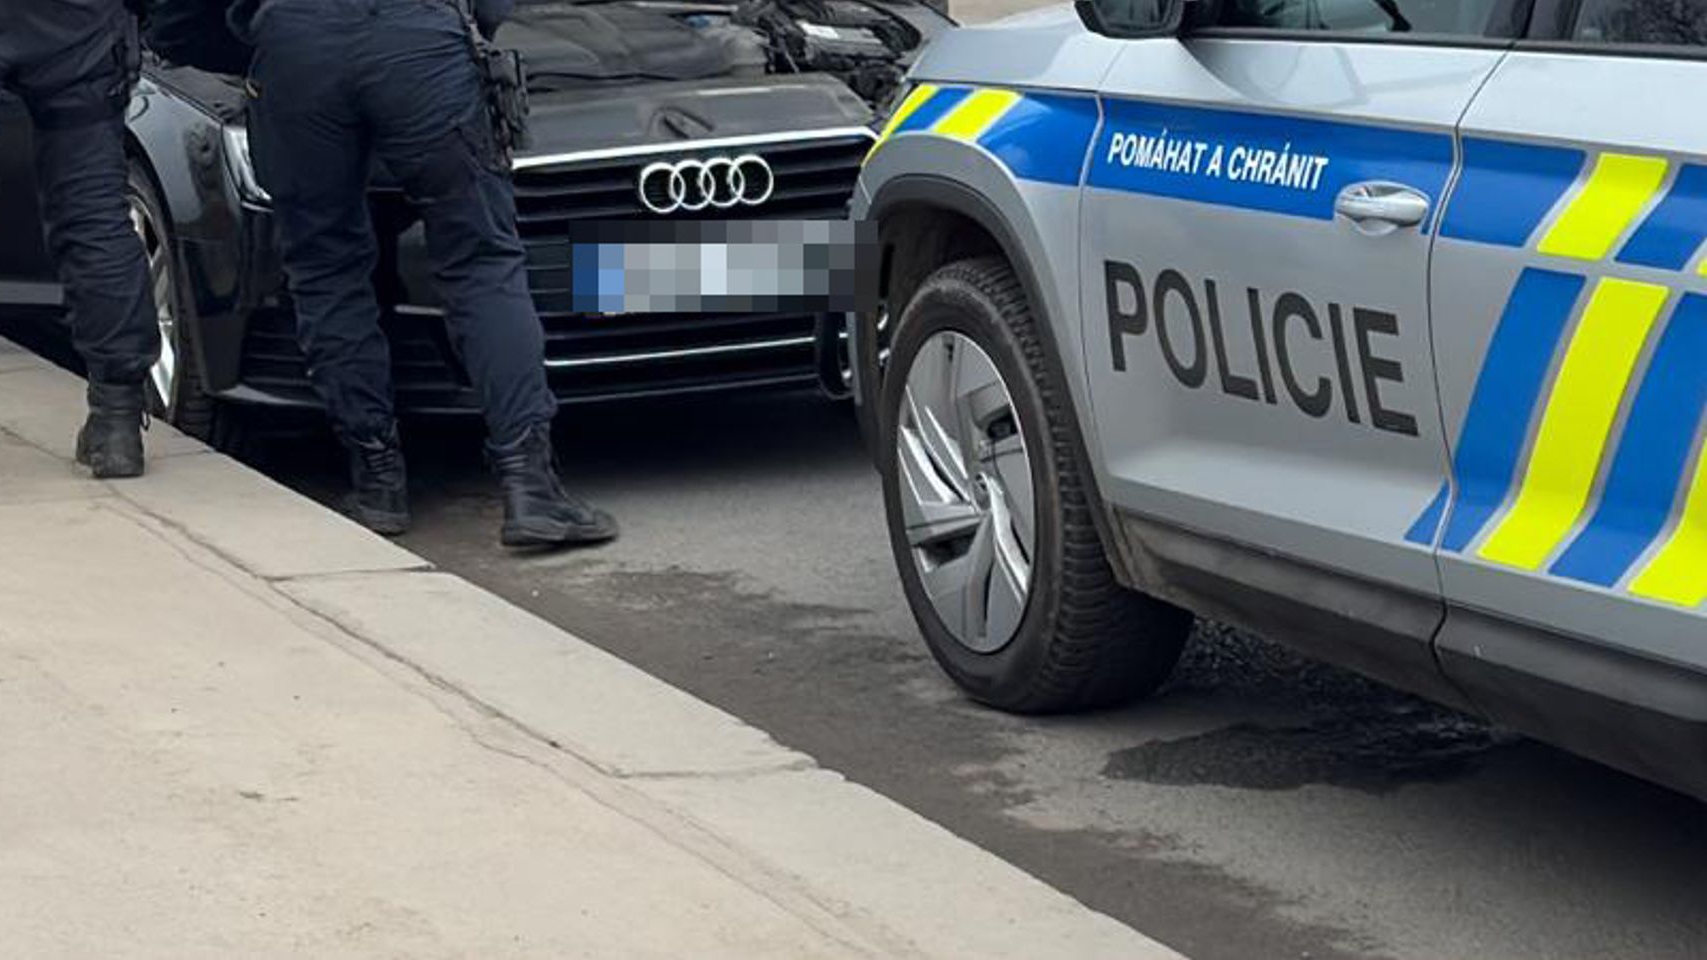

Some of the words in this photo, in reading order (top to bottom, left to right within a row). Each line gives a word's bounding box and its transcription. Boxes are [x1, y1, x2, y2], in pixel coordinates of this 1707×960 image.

[1107, 127, 1208, 174] POMÁHAT
[1206, 145, 1225, 178] A
[1227, 142, 1329, 191] CHRÁNIT
[1104, 259, 1420, 437] POLICIE
